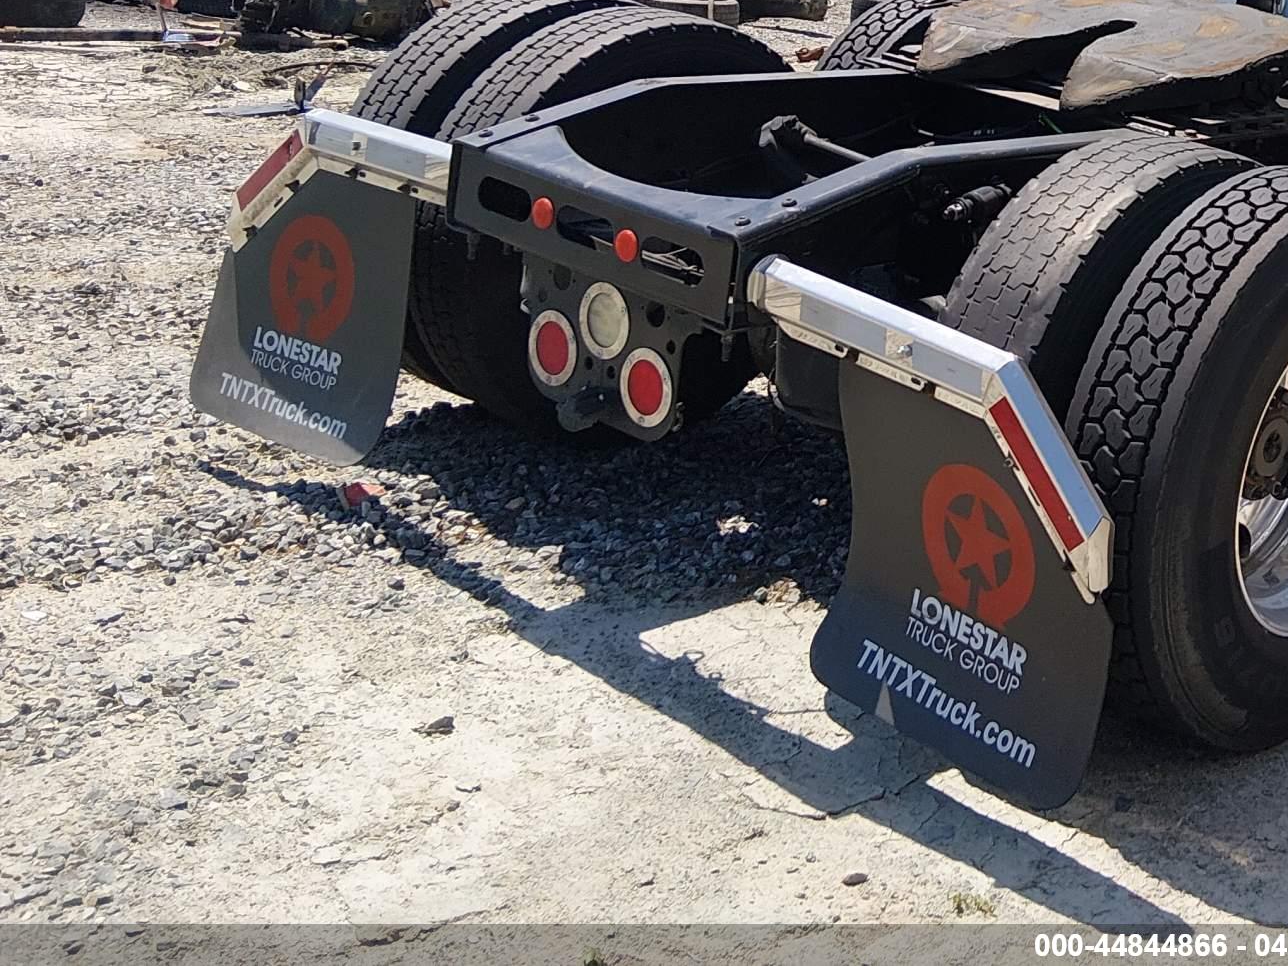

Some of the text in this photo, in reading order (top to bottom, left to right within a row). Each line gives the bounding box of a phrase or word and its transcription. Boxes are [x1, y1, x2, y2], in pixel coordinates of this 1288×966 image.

[251, 350, 338, 391] TRUCK GROUP
[253, 326, 342, 375] LONESTAR
[219, 372, 347, 440] TNTXTruck.com
[905, 616, 1021, 694] TRUCK GROUP
[910, 587, 1028, 677] LONESTAR
[856, 638, 1037, 768] TNTXTruck.com
